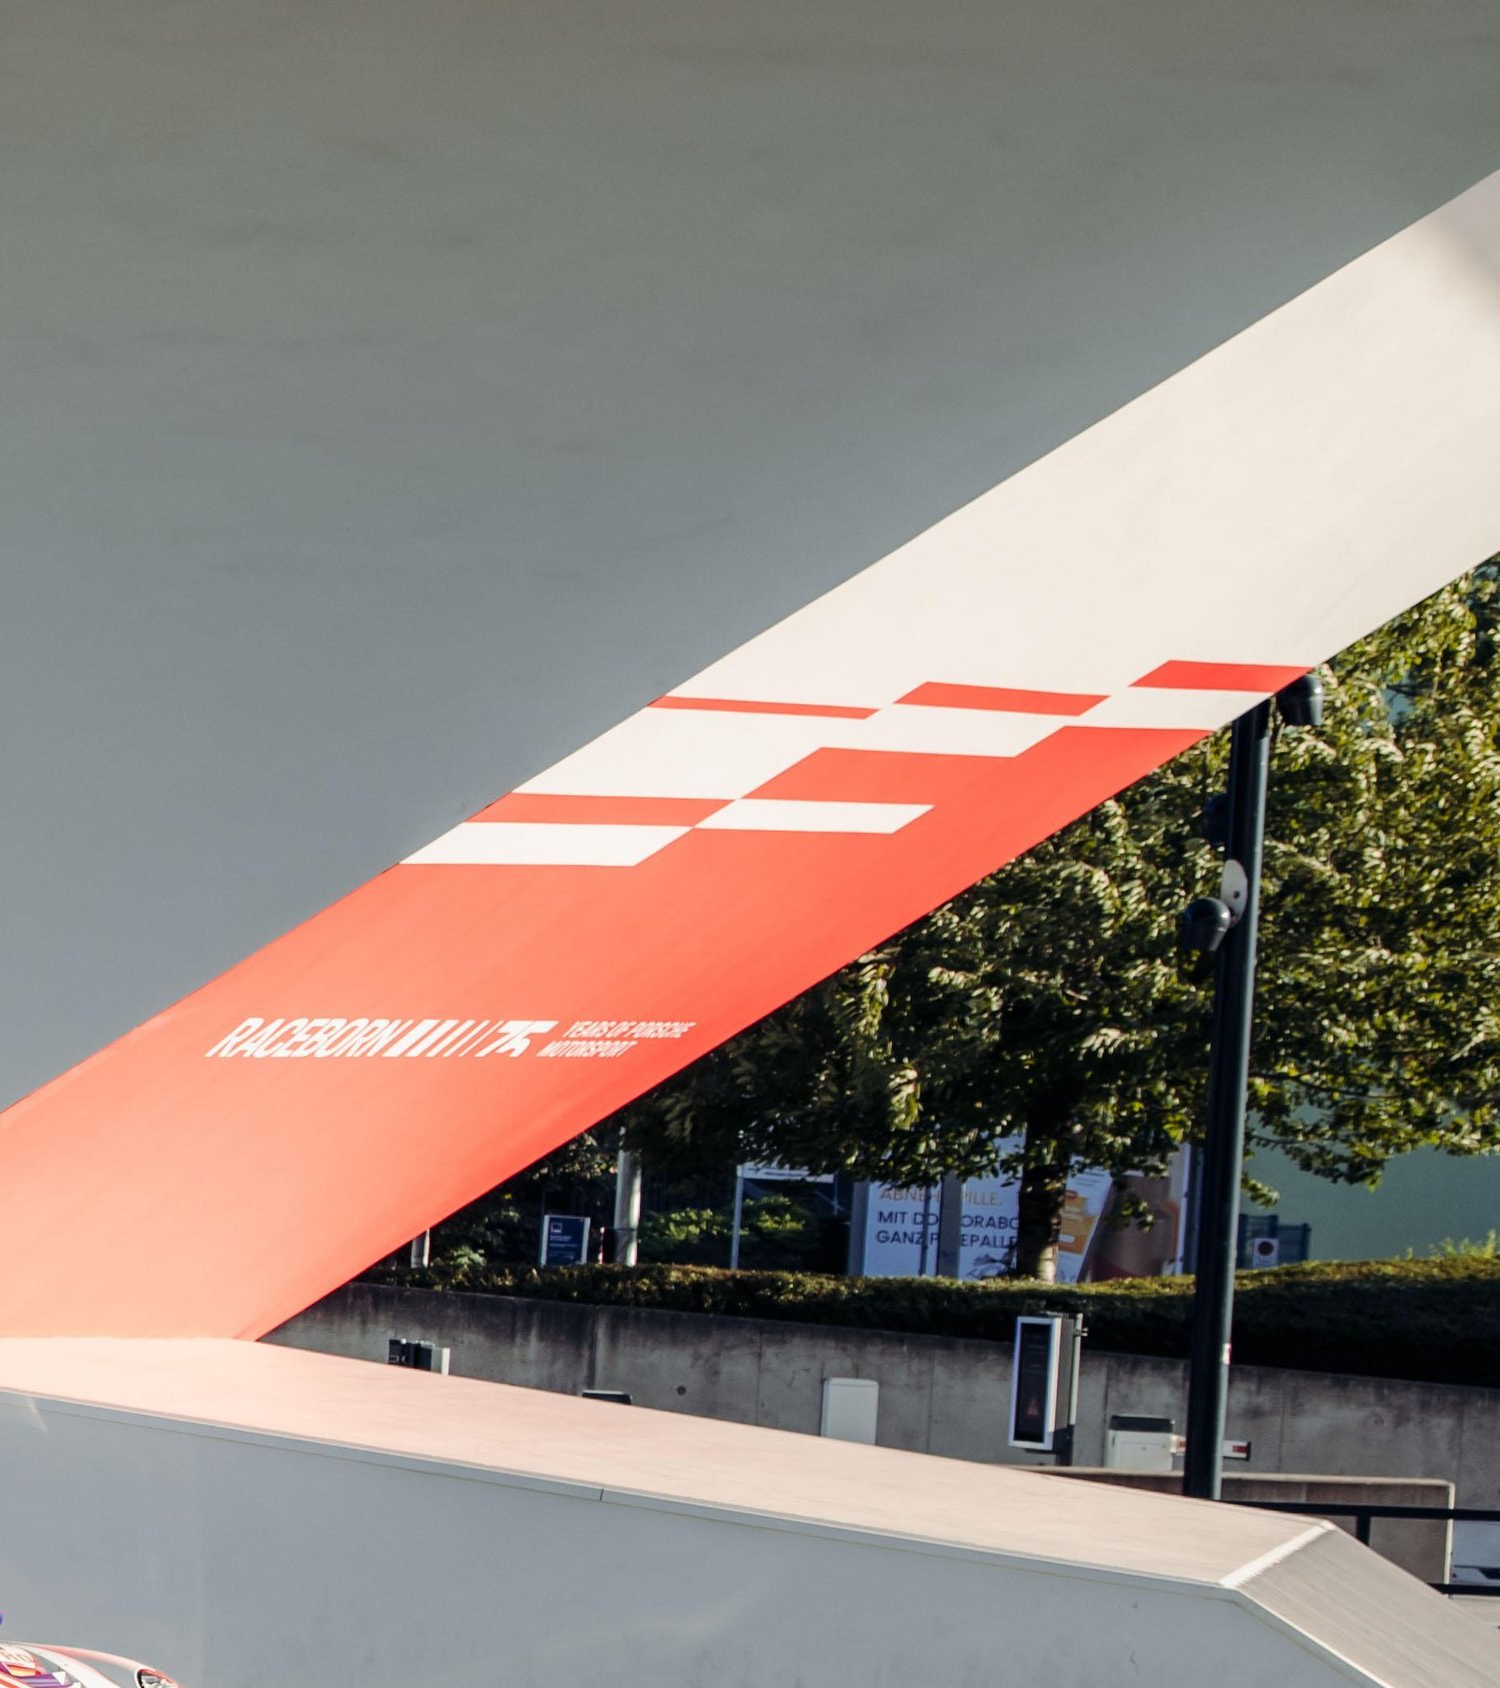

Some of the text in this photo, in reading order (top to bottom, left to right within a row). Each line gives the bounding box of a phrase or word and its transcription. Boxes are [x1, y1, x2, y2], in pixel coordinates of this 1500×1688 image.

[204, 1017, 406, 1058] RACEBORN
[562, 1021, 610, 1038] YEARS
[536, 1040, 637, 1058] MOTORSPORT
[878, 1211, 1019, 1231] MIT DOORABO
